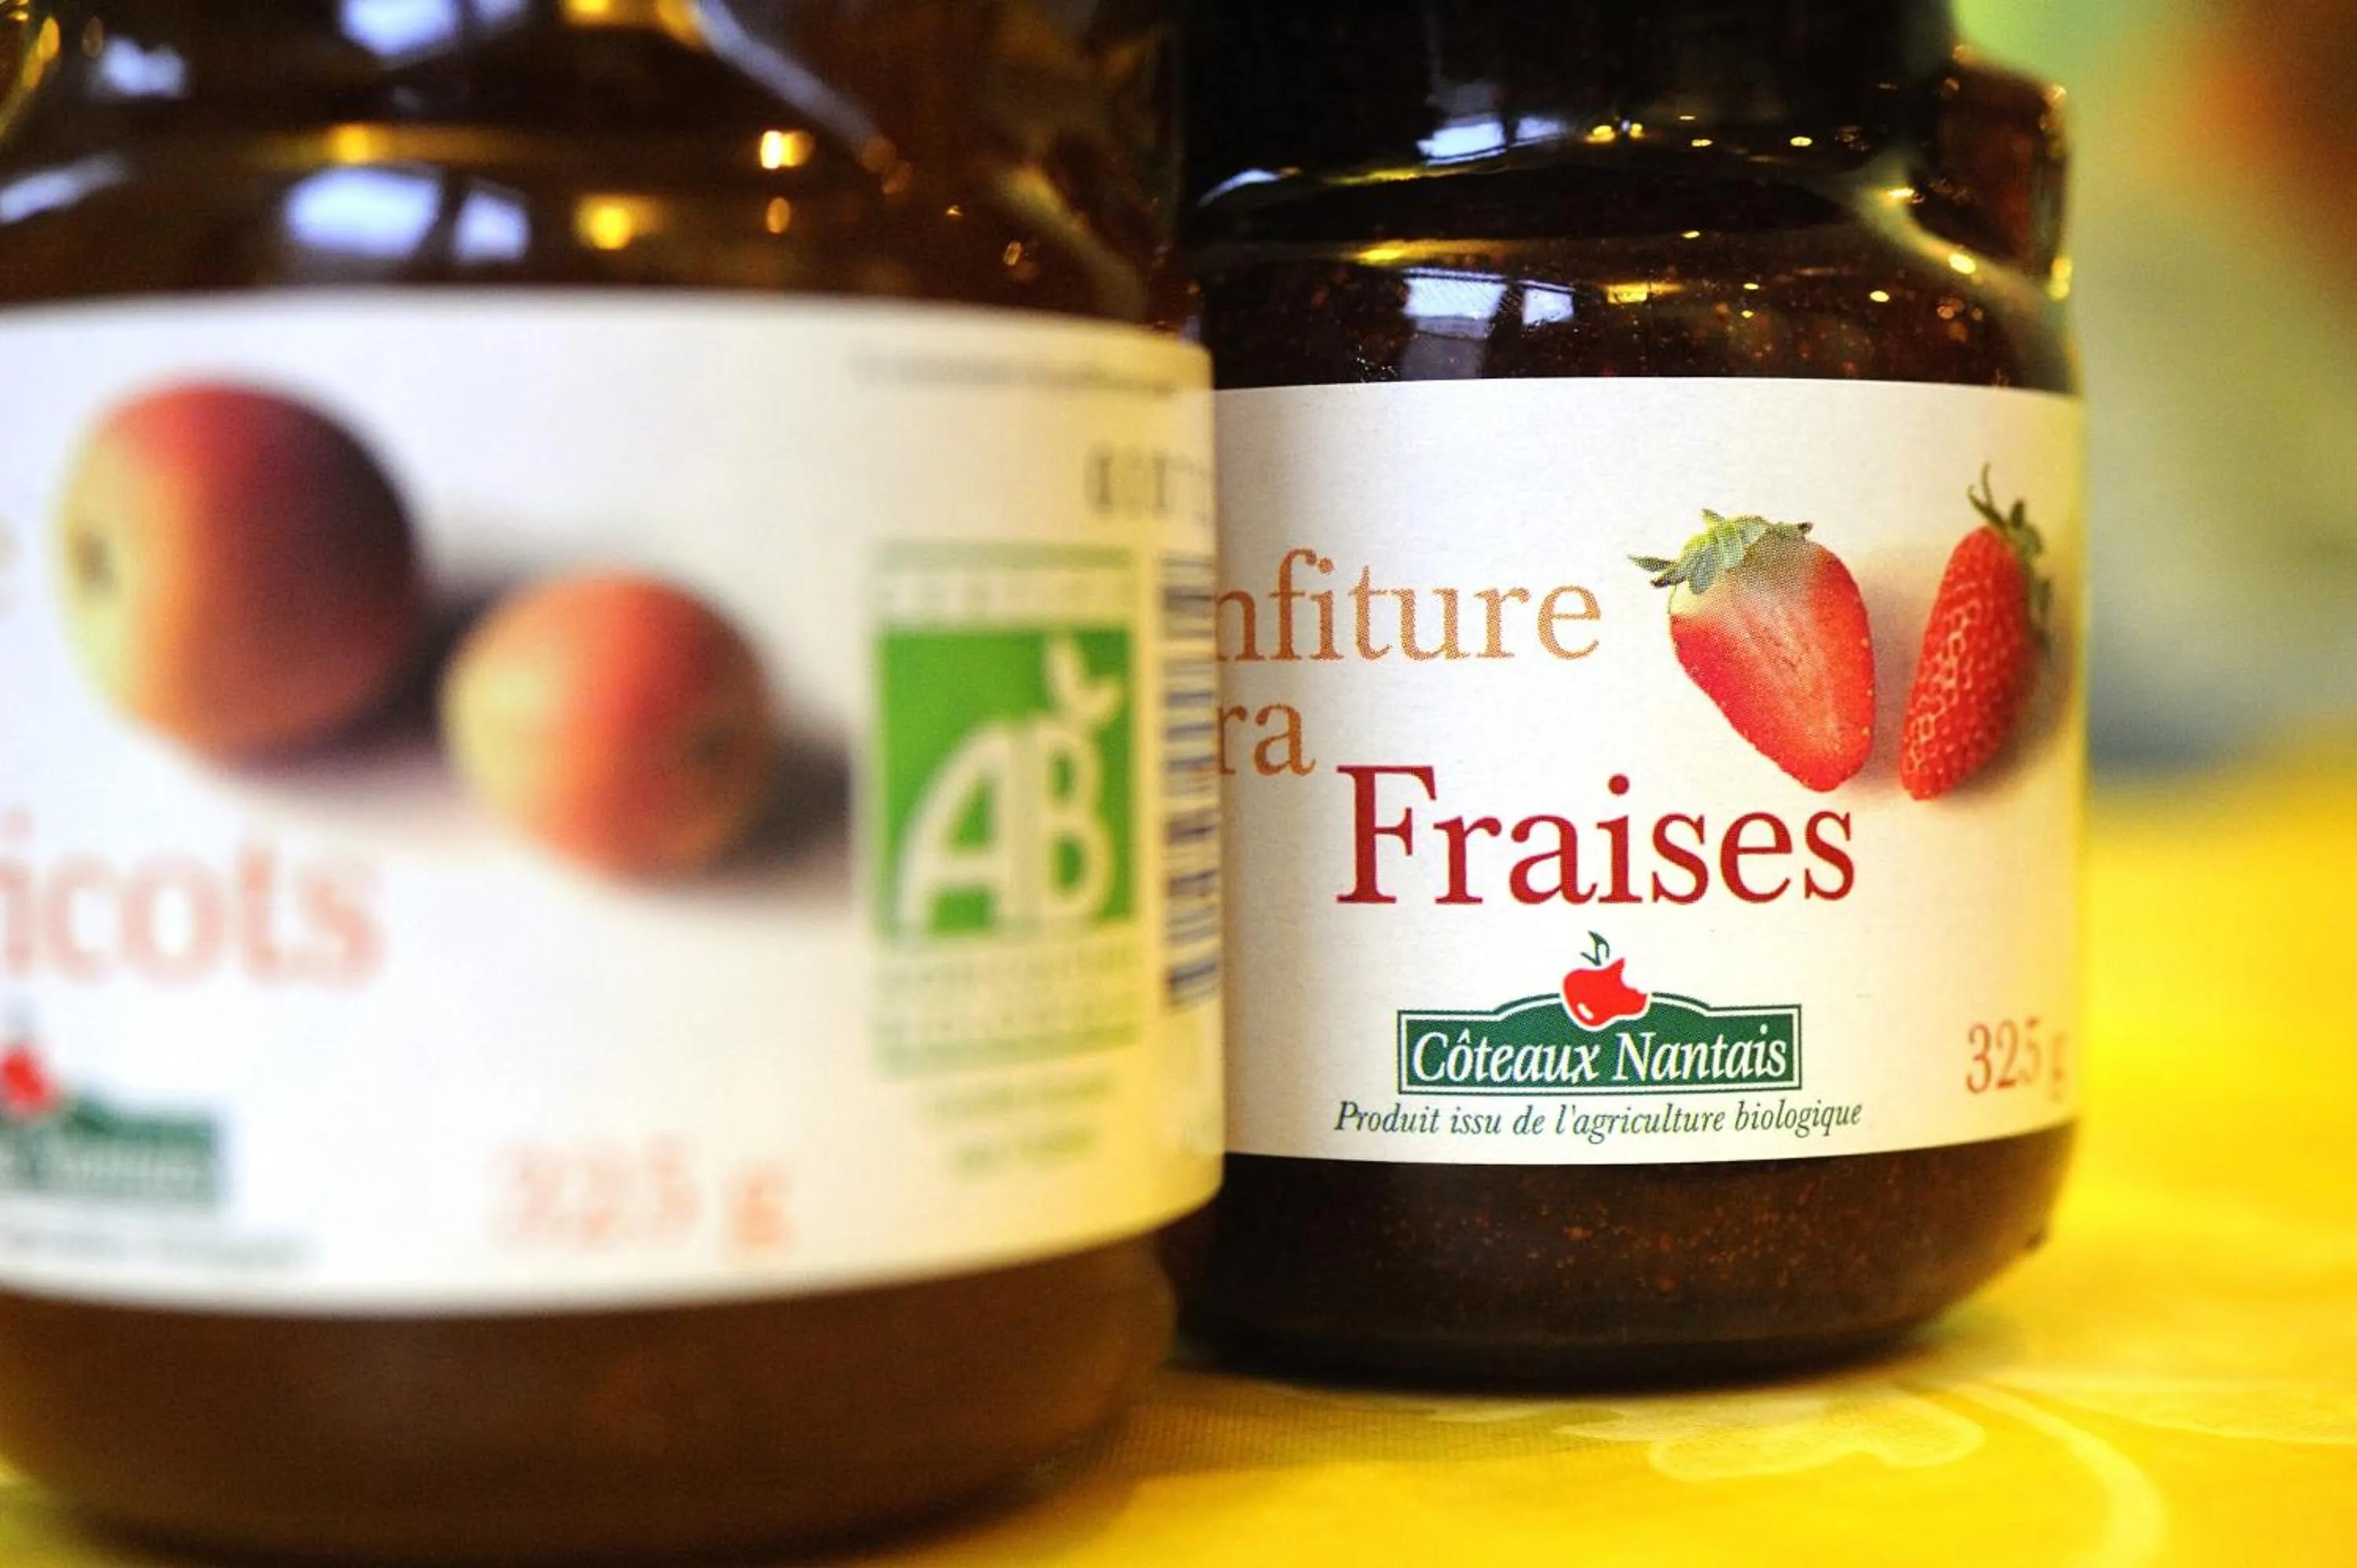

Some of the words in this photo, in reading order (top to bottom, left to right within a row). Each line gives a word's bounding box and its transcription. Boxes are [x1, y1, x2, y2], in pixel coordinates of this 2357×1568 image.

[896, 721, 1116, 935] AB
[1336, 765, 1855, 905] Fraises
[1413, 1026, 1600, 1084] Côteaux
[1611, 1023, 1787, 1083] Nantais
[1965, 1017, 2042, 1095] 325
[1333, 1100, 1441, 1134] Produit
[1449, 1106, 1502, 1135] issu
[1512, 1105, 1546, 1136] de
[1554, 1101, 1726, 1145] l'agriculture
[1734, 1097, 1863, 1138] biologique
